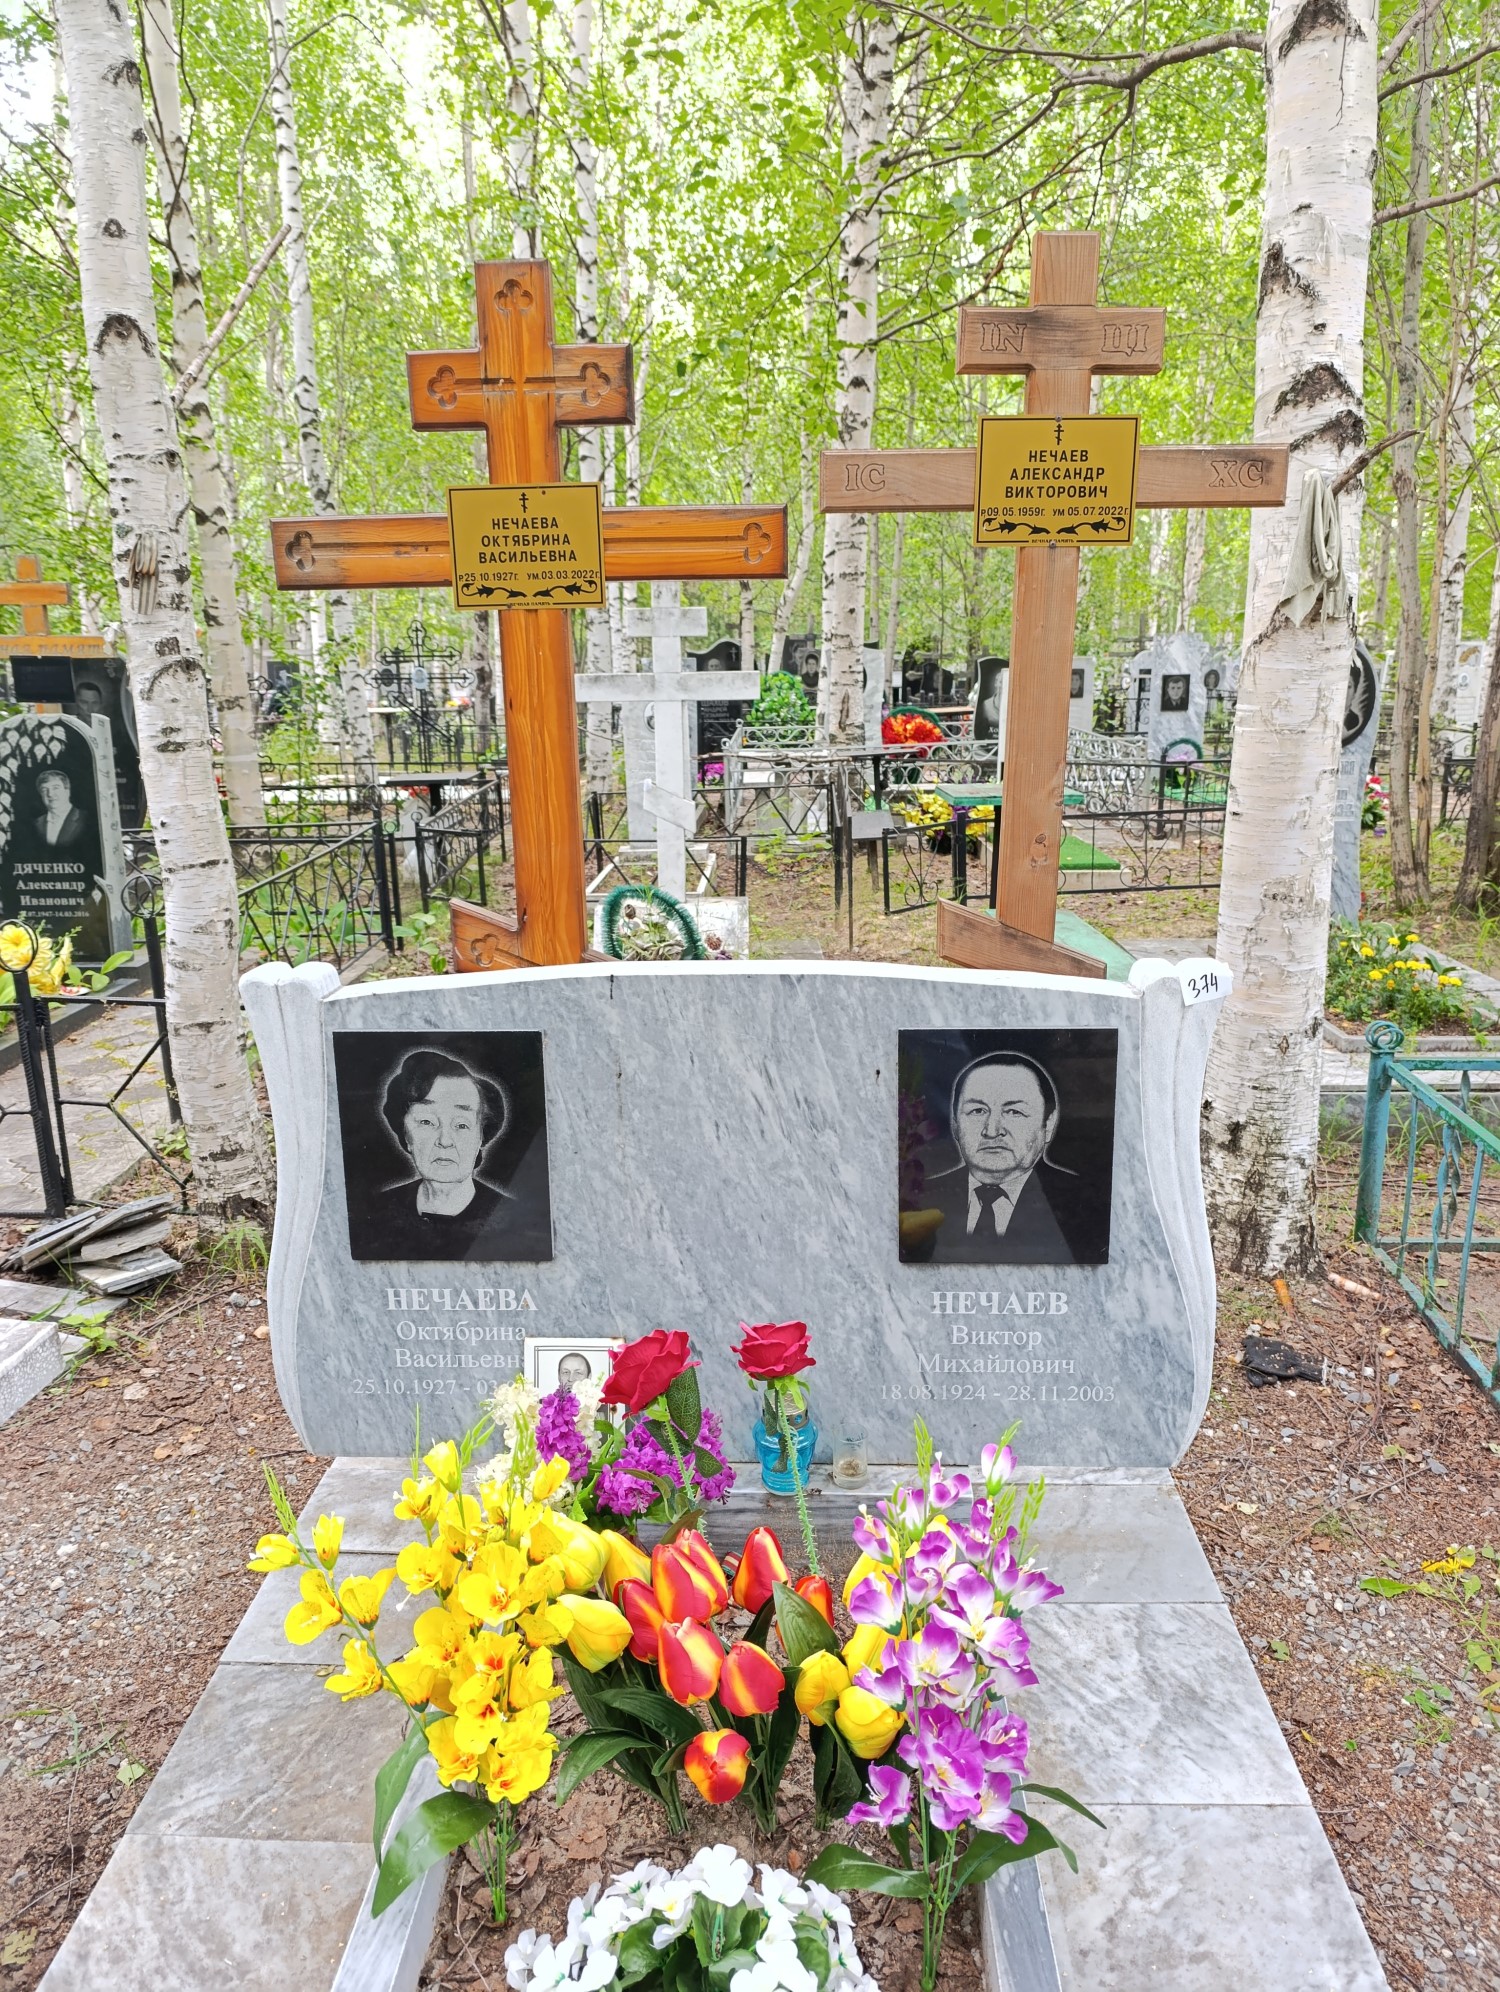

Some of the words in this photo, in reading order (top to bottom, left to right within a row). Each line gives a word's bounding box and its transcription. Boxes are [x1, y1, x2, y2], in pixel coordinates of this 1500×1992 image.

[1028, 449, 1089, 463] НЕЧАЕВ
[1009, 467, 1105, 482] АЛЕКСАНДР
[1005, 485, 1108, 499] ВИКТОРОВИЧ
[491, 516, 559, 530] НЕЧАЕВА
[481, 533, 571, 548] ОКТЯБРИНА
[478, 550, 577, 564] ВАСИЛЬЕВНА
[13, 862, 85, 876] ДЯЧЕНКО
[16, 880, 86, 892] Александр
[20, 895, 85, 906] Иванович
[1187, 972, 1218, 999] 374
[385, 1287, 539, 1311] НЕЧАЕВА
[930, 1291, 1069, 1315] НЕЧАЕВ
[396, 1320, 526, 1345] Октябрина
[950, 1325, 1042, 1350] Виктор
[395, 1348, 526, 1368] Васильевн
[917, 1353, 1076, 1374] Михайлович
[352, 1379, 457, 1395] 25.10.1927
[880, 1384, 987, 1401] 18.08.1924
[1007, 1385, 1116, 1402] 28.11.2003
